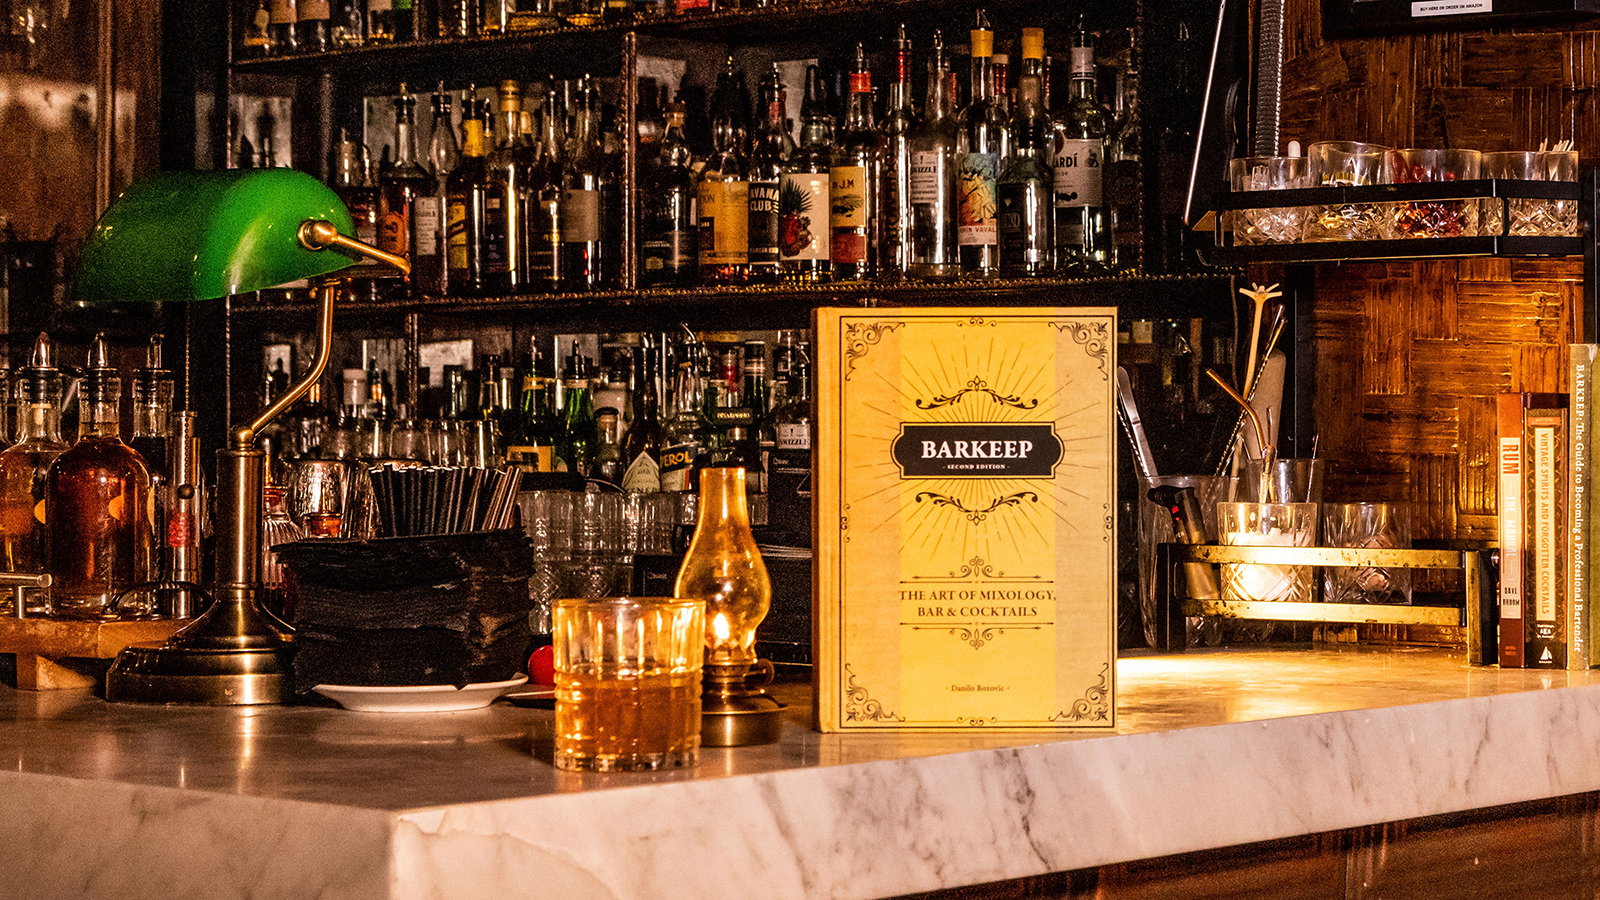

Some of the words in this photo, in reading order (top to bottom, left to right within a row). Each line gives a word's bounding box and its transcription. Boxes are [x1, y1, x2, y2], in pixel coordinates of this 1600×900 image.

[1575, 364, 1585, 421] BARKEEP:
[1575, 422, 1585, 441] The
[921, 440, 1033, 459] BARKEEP
[1502, 444, 1519, 475] RUM
[1540, 432, 1549, 467] VINTAGE
[1575, 442, 1585, 472] Guide
[1540, 469, 1549, 500] SPIRITS
[1575, 473, 1583, 484] to
[1505, 496, 1516, 513] THE
[1541, 502, 1549, 520] AND
[1573, 485, 1584, 534] Becoming
[1505, 520, 1517, 559] MANUAL
[1541, 521, 1550, 569] FORGOTTEN
[1574, 542, 1584, 602] Professional
[899, 590, 925, 601] THE
[929, 590, 956, 601] ART
[959, 590, 977, 601] OF
[980, 590, 1057, 602] MIXOLOGY,
[1502, 598, 1520, 606] BROOM
[1504, 587, 1518, 595] DAVE
[1541, 570, 1550, 615] COCKTAILS
[918, 607, 944, 617] BAR
[947, 607, 957, 617] &
[960, 606, 1038, 617] COCKTAILS
[1573, 603, 1584, 653] Bartender
[951, 684, 976, 692] Danilo
[977, 684, 1005, 692] Bozovic
